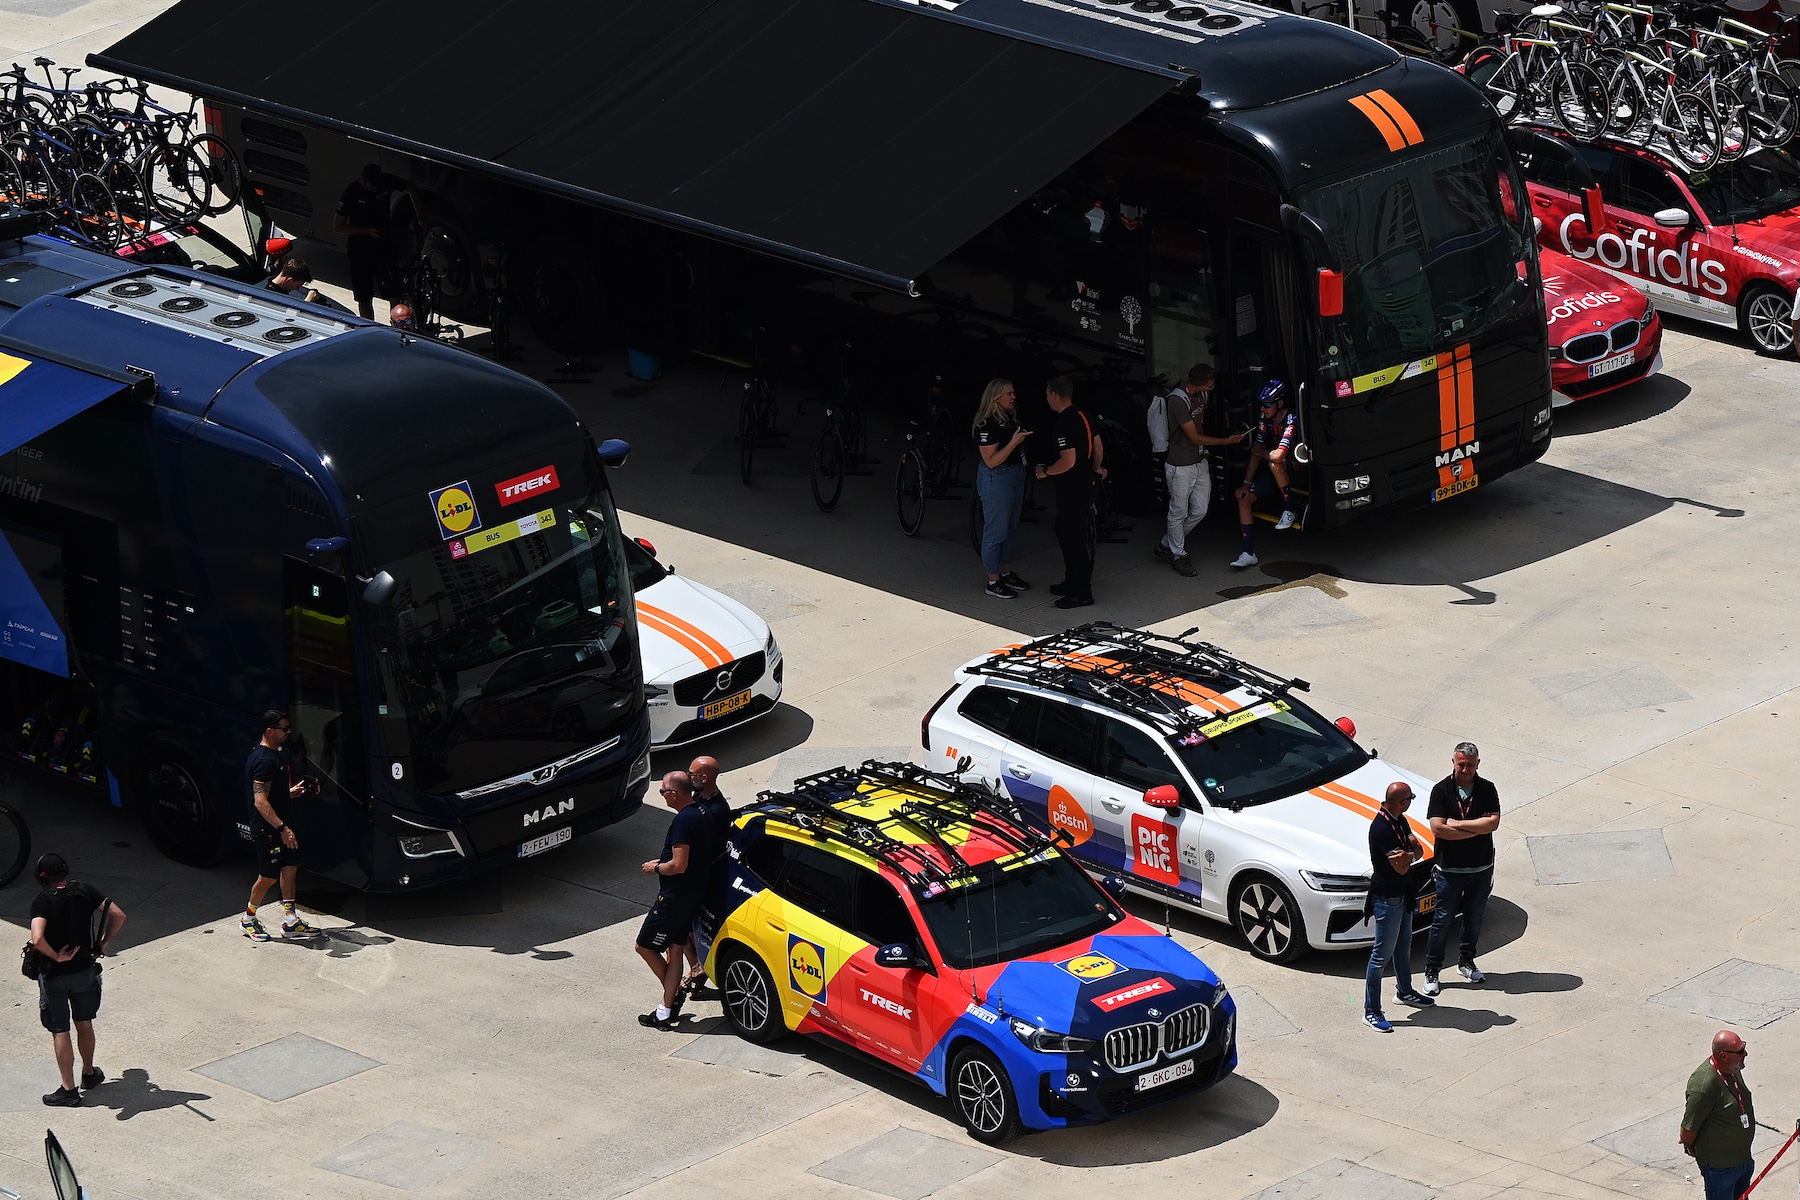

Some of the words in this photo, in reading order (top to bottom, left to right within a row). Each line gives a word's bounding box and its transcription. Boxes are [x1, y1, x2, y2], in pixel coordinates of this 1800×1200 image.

[1559, 211, 1729, 296] Cofidis
[1733, 245, 1783, 269] #COFIDISMYTEAM
[1372, 374, 1387, 384] BUS
[1423, 358, 1435, 368] 347
[1434, 441, 1481, 468] MAN
[501, 472, 553, 498] TREK
[1436, 475, 1477, 500] 99-BDK-6
[485, 531, 501, 543] BUS
[539, 513, 553, 524] 343
[706, 692, 750, 718] HBP-08-K
[1215, 785, 1226, 795] 17
[522, 797, 575, 827] MAN
[1052, 808, 1089, 833] postnl
[1137, 825, 1171, 854] PIC
[858, 986, 914, 1021] TREK
[1100, 981, 1164, 1006] TREK
[966, 1002, 999, 1025] PIRELLI
[1140, 1061, 1194, 1088] 2-GKC-094
